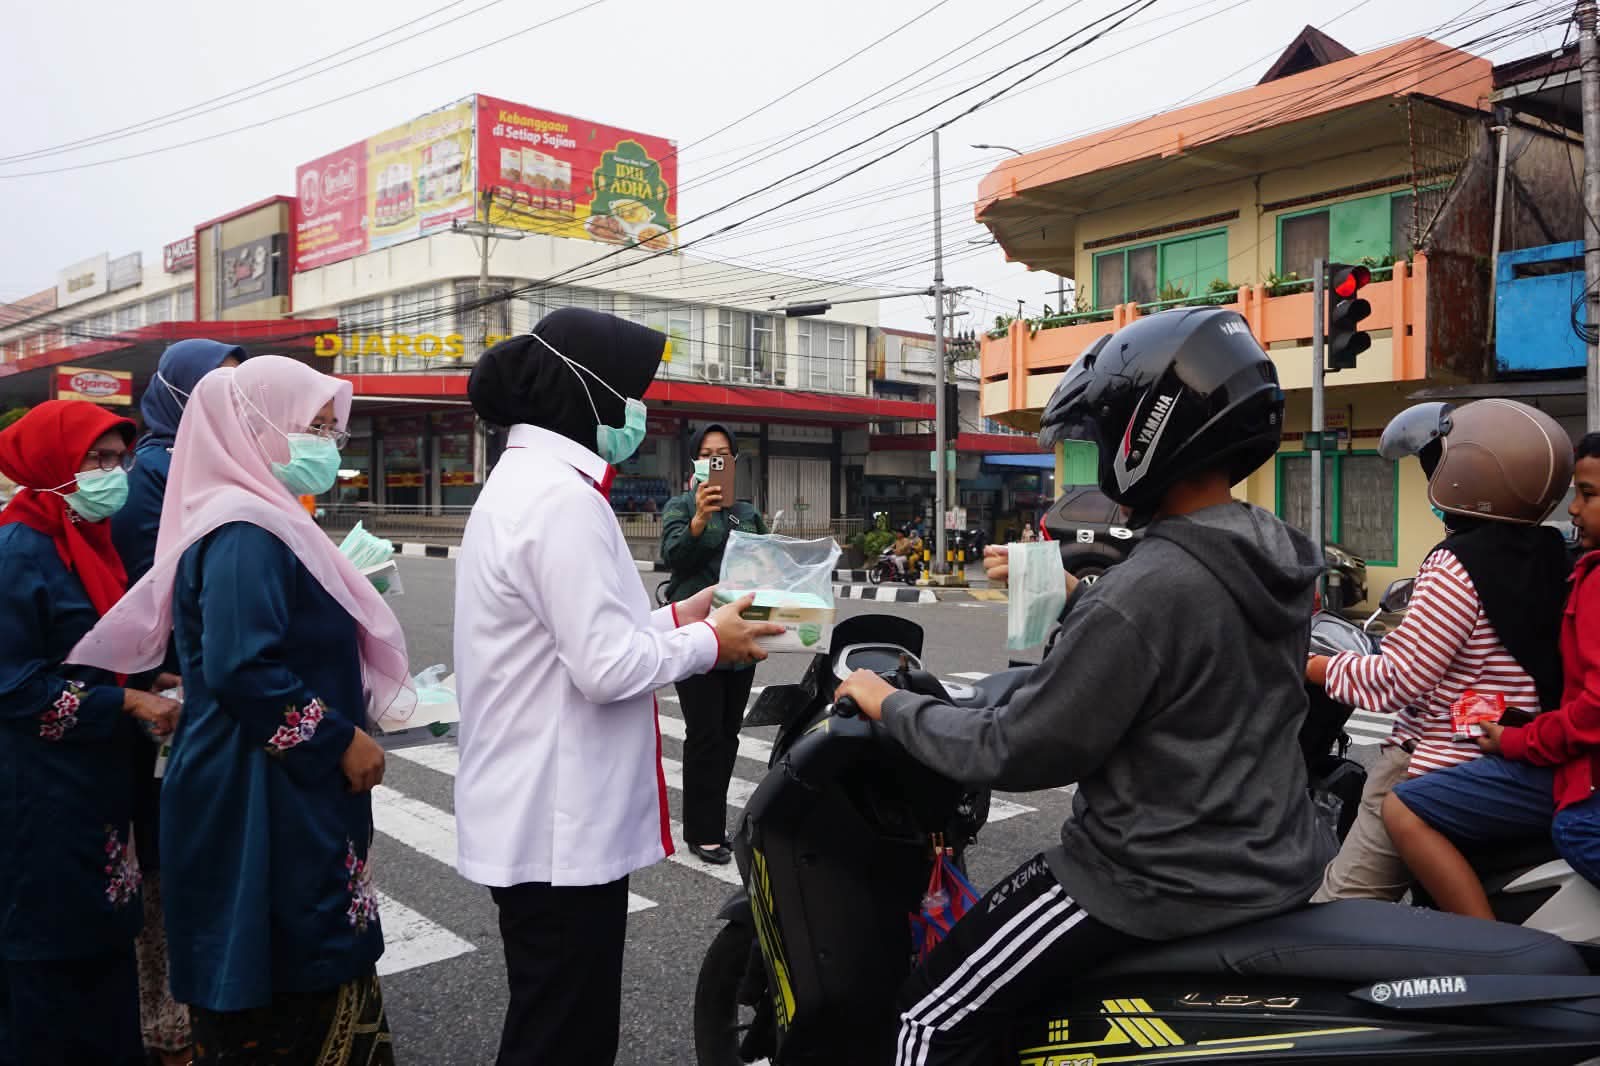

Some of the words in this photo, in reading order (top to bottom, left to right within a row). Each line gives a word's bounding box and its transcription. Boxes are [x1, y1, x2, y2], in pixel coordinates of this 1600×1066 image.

[499, 111, 568, 132] Kebanggaan
[492, 123, 504, 137] di
[505, 126, 541, 145] Setiap
[542, 133, 576, 149] Sajian
[610, 178, 652, 199] ADHA
[314, 333, 465, 358] DJAROS
[1137, 394, 1174, 444] YAMAHA
[1391, 977, 1467, 998] YAMAHA
